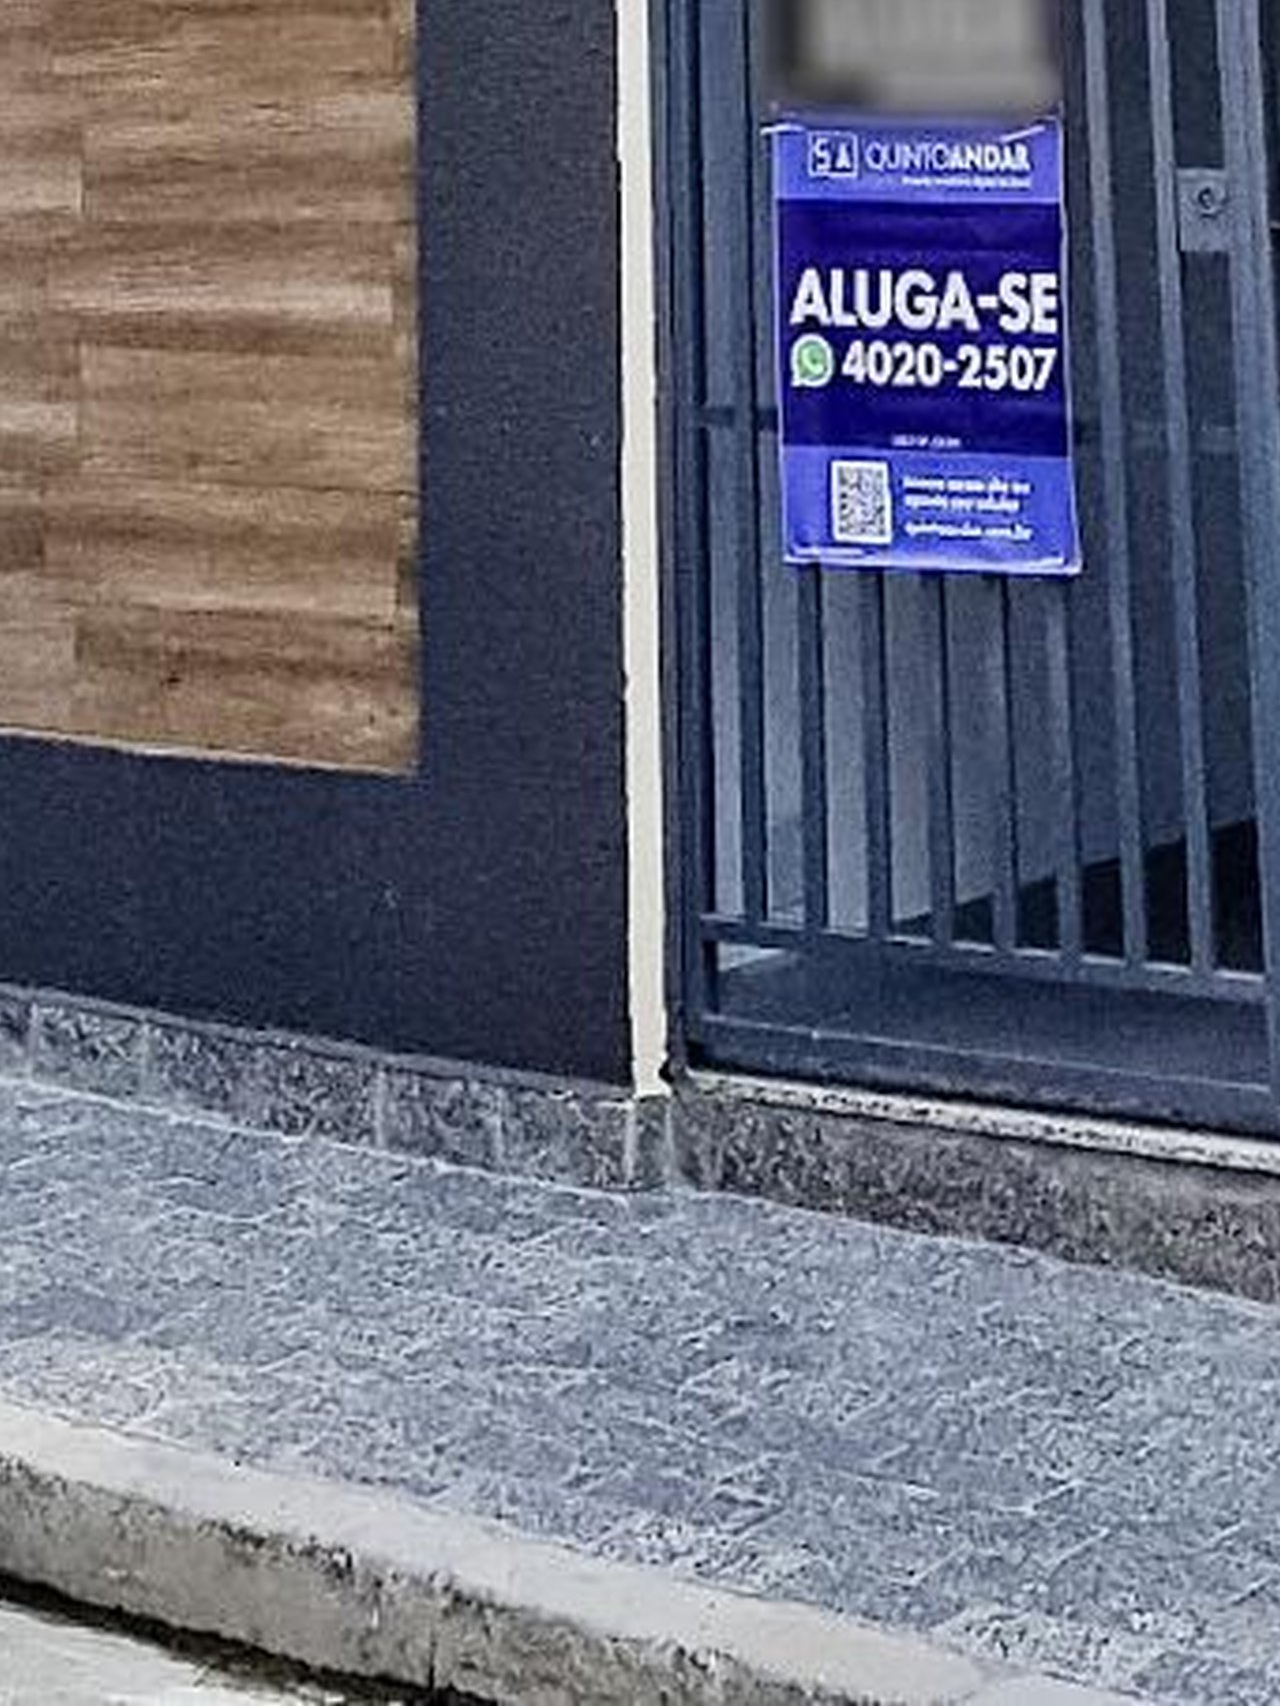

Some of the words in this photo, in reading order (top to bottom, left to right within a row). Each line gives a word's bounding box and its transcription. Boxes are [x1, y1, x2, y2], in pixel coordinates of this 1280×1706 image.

[865, 141, 1032, 171] QUINTOANDAR
[789, 267, 1059, 334] ALUGA-SE
[840, 340, 1058, 391] 4020-2507
